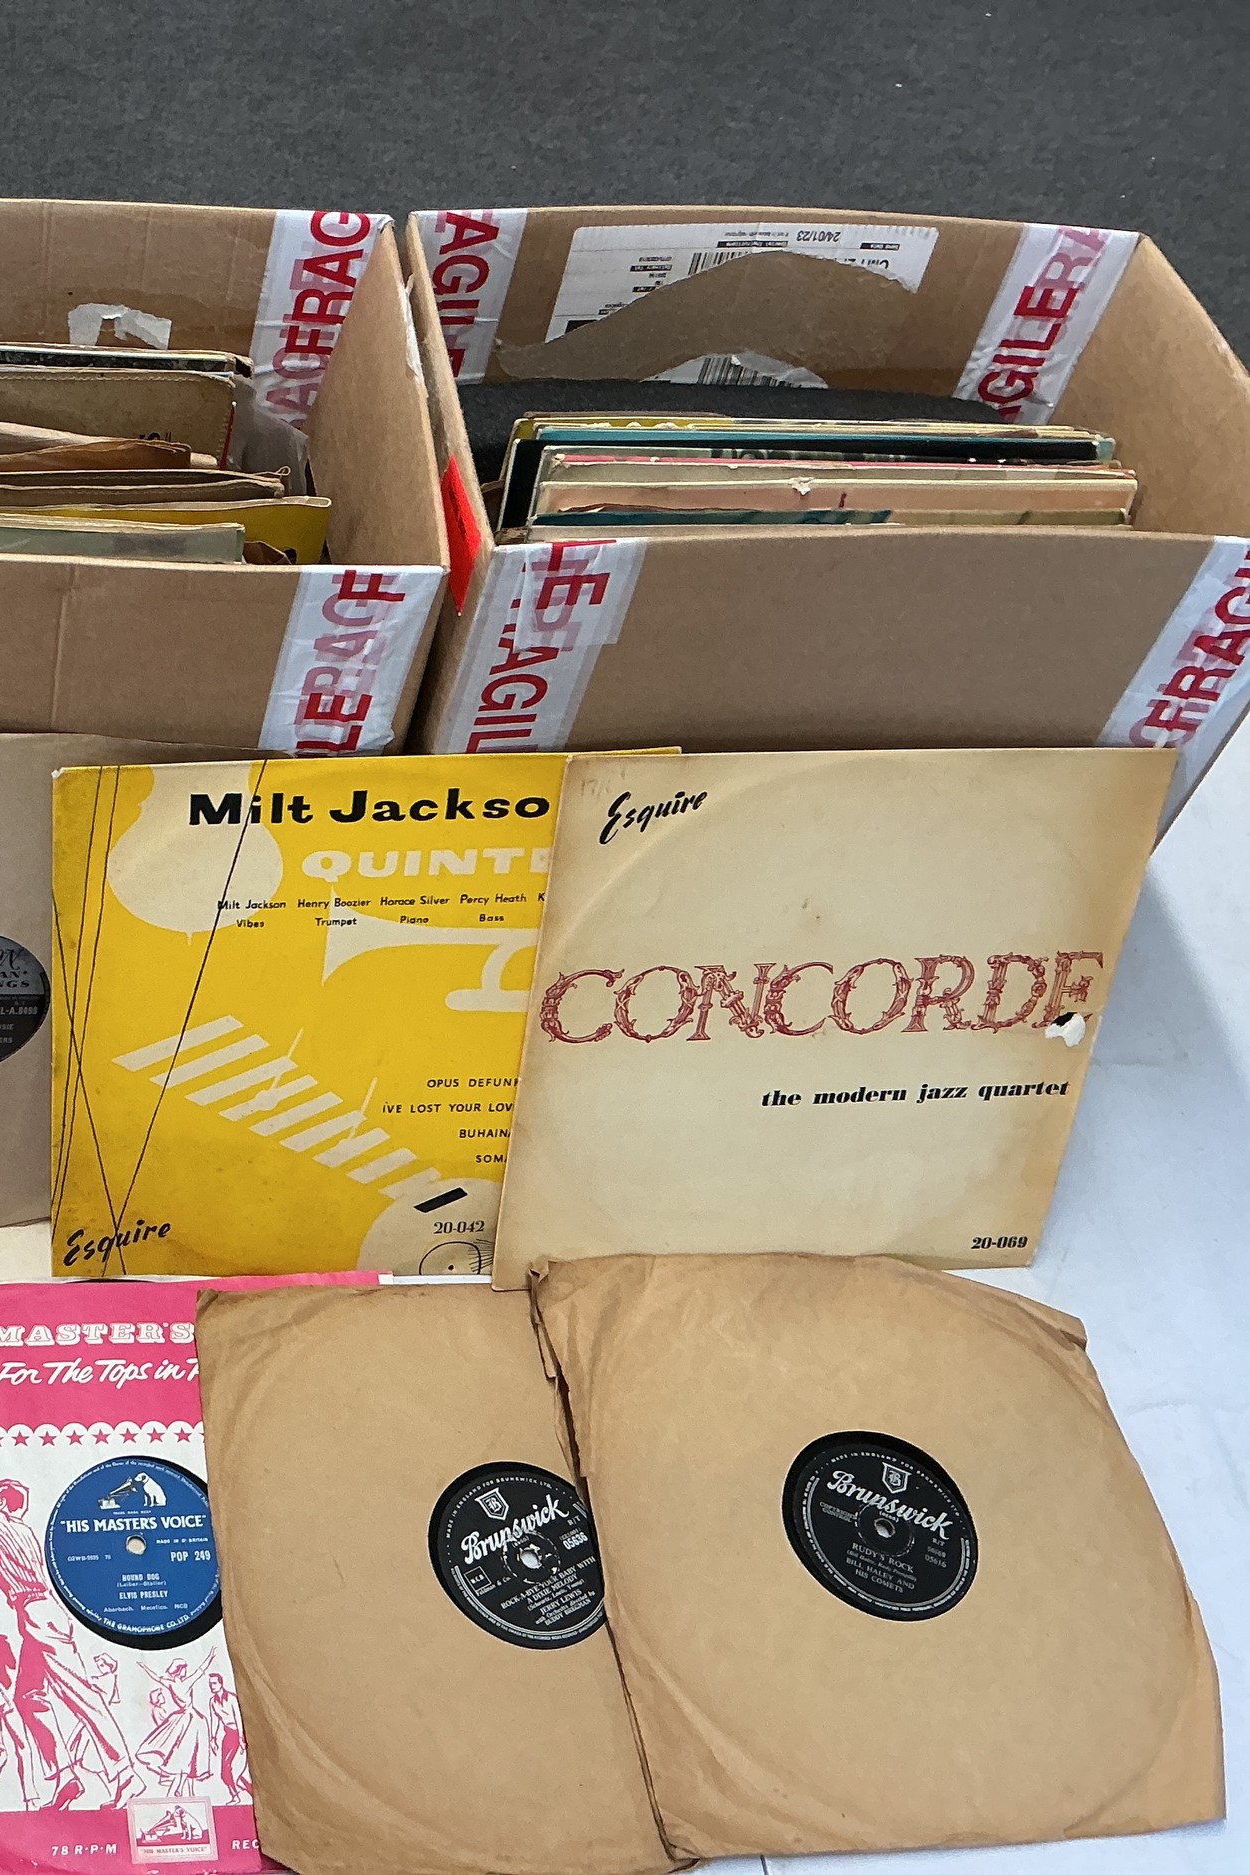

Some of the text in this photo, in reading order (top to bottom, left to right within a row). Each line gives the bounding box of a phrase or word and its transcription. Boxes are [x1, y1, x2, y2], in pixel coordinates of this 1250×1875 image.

[796, 231, 841, 242] 24/01/23
[188, 788, 552, 827] Milt Jackso
[598, 789, 708, 845] Esquire
[217, 899, 241, 911] Milt
[245, 899, 287, 910] Jackson
[297, 897, 330, 910] Henry
[379, 896, 416, 907] Horace
[419, 894, 450, 906] Silver
[459, 893, 491, 906] Percy
[494, 892, 527, 904] Heath
[236, 913, 505, 929] Vibes Trumpet Piano Bass
[539, 949, 1105, 1045] CONCORDE
[426, 1078, 460, 1089] OPUS
[760, 1078, 1071, 1108] the modern jazz quartet
[409, 1103, 442, 1113] LOST
[448, 1103, 482, 1113] YOUR
[433, 1220, 486, 1235] 20-042
[63, 1219, 172, 1267] Esquire
[970, 1235, 1029, 1251] 20-069
[46, 1357, 93, 1385] The
[97, 1359, 148, 1390] Tops
[151, 1360, 179, 1381] in
[826, 1470, 953, 1540] Brunswick
[461, 1494, 570, 1564] Brunswick
[563, 1532, 588, 1550] 05636
[170, 1550, 211, 1562] POP 249
[846, 1557, 865, 1570] BILL
[888, 1557, 914, 1573] ROCK
[559, 1566, 576, 1579] BABY
[577, 1556, 596, 1569] WITH
[119, 1590, 169, 1600] ELVIS PRESLEY
[533, 1588, 551, 1600] DIXIE
[551, 1573, 578, 1591] MELODY
[540, 1589, 582, 1615] JERRY LEWIS
[51, 1846, 69, 1856] 78
